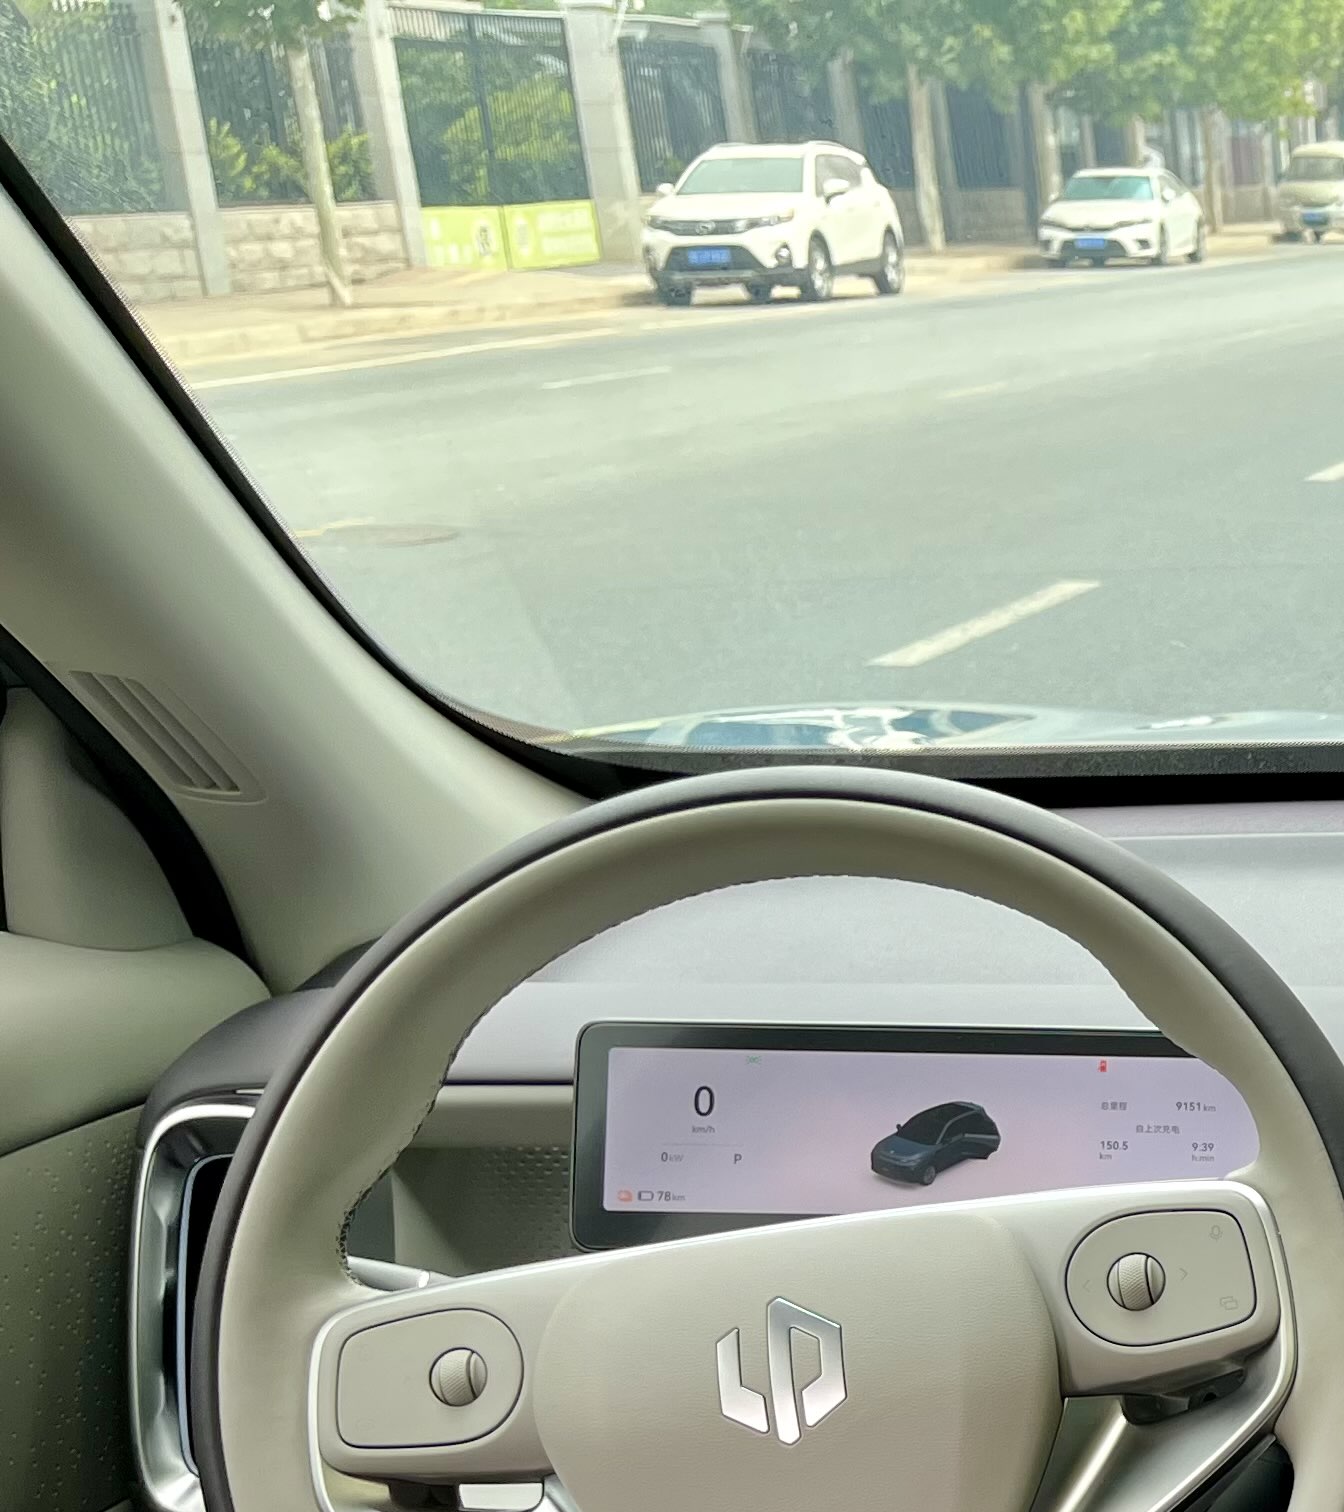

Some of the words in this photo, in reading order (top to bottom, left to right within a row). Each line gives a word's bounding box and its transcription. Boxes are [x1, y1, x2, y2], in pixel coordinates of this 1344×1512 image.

[694, 1085, 715, 1117] 0
[1176, 1101, 1201, 1112] 9151
[691, 1125, 716, 1134] km/h
[1100, 1141, 1129, 1151] 150.5
[660, 1151, 669, 1162] 0
[733, 1153, 742, 1165] P
[657, 1190, 671, 1202] 78
